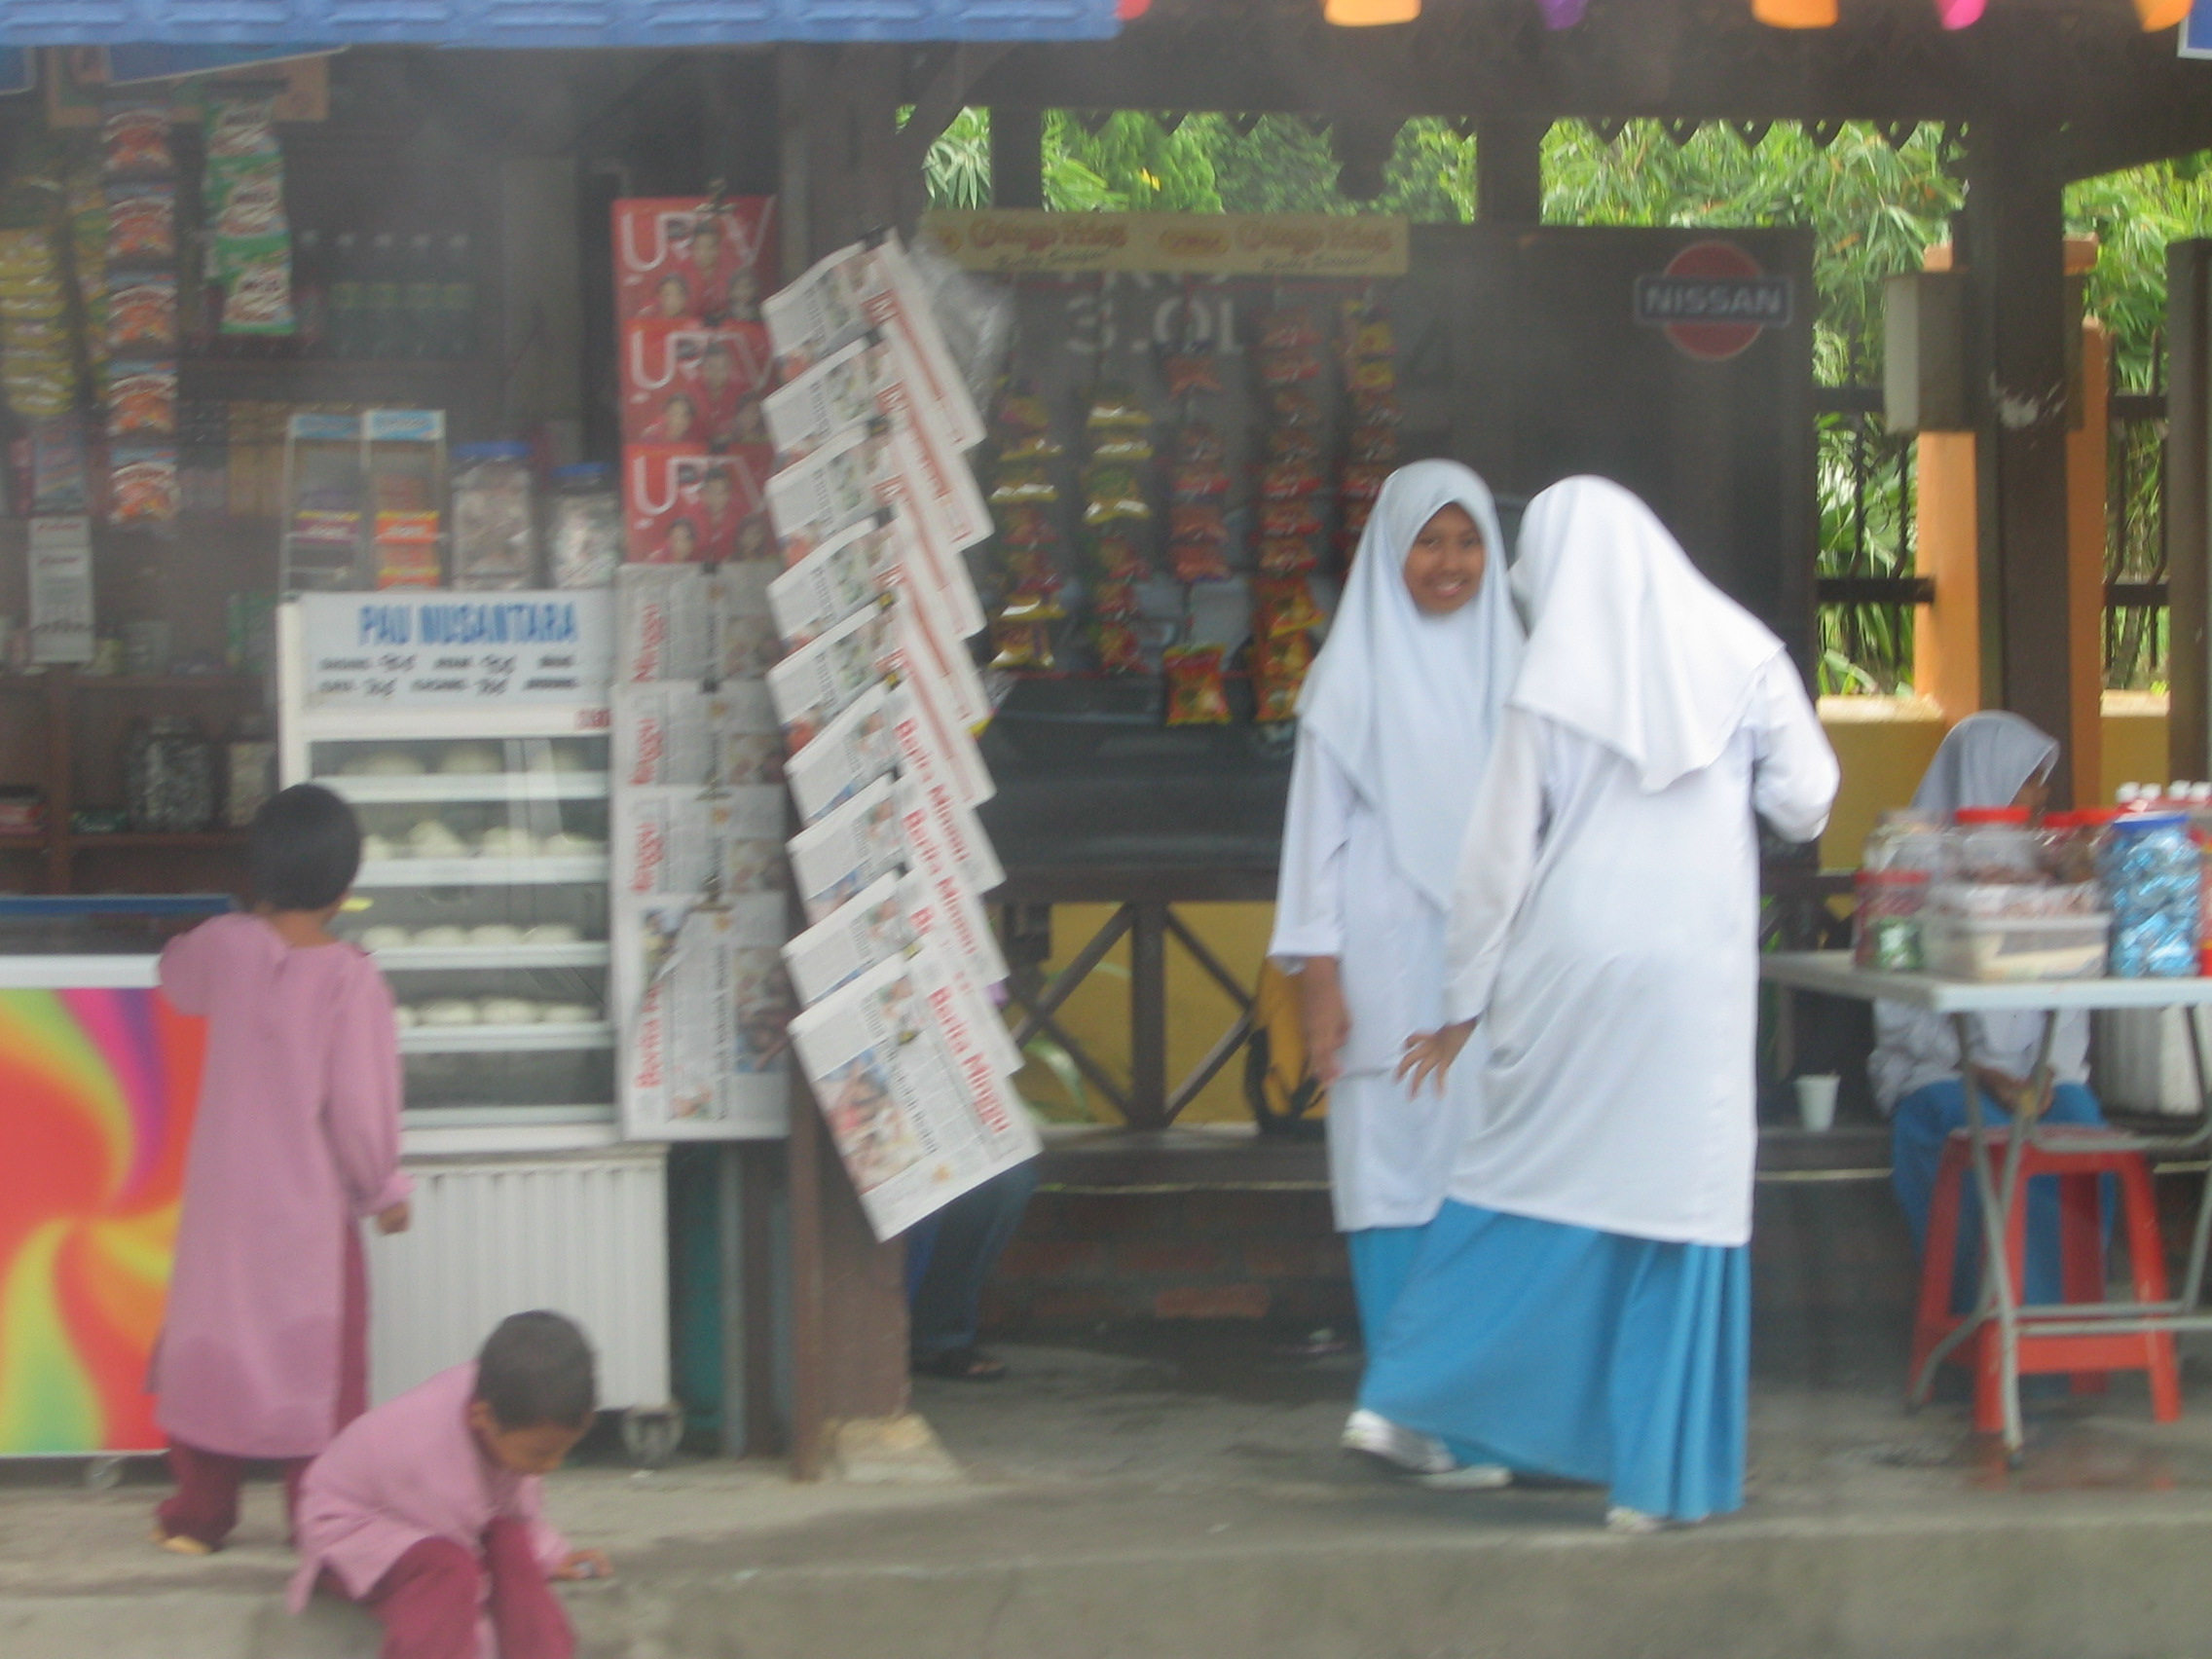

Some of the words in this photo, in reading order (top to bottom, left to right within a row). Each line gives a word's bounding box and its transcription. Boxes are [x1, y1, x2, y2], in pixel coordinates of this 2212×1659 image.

[1645, 286, 1782, 314] NISSAN
[358, 605, 411, 645] PAU
[419, 601, 579, 645] NUSANTARA
